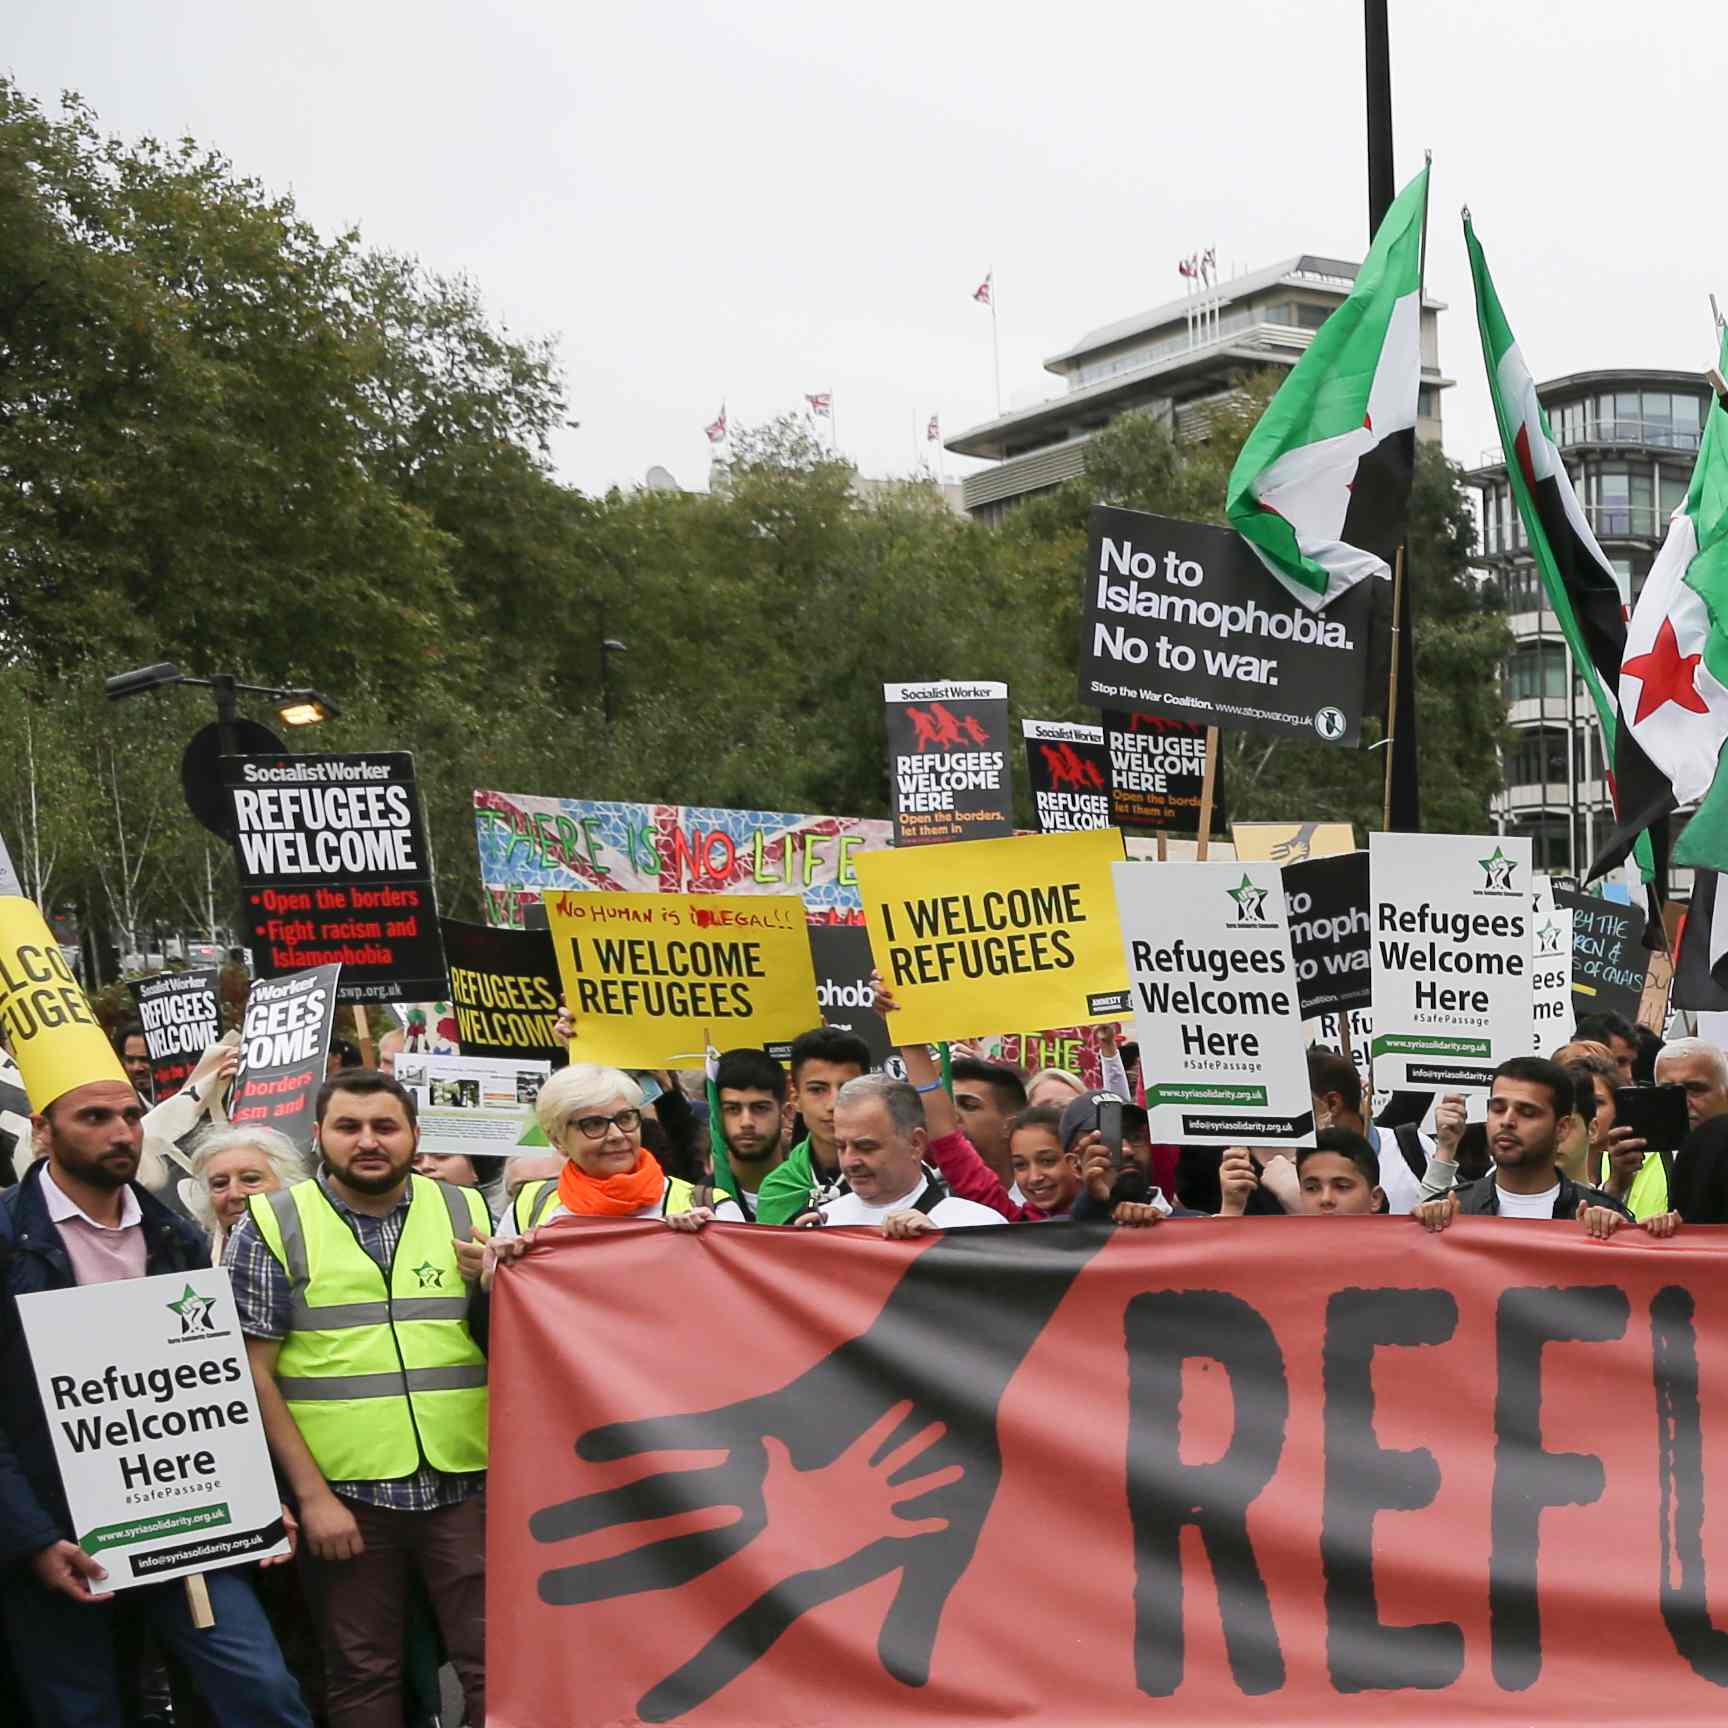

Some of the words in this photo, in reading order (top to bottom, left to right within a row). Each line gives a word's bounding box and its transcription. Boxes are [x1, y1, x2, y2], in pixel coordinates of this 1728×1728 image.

[1100, 537, 1156, 579] No
[1163, 551, 1204, 587] to
[1097, 575, 1354, 650] Islamophobia.
[1093, 623, 1148, 664] No
[1156, 635, 1196, 671] to
[1203, 649, 1278, 686] war.
[1090, 680, 1118, 697] Stop
[1119, 685, 1138, 700] the
[1139, 688, 1162, 703] War
[1163, 692, 1214, 711] Coalition.
[1108, 731, 1207, 757] REFUGEE
[896, 751, 1004, 775] REFUGEES
[1109, 751, 1206, 777] WELCOM
[896, 770, 1001, 794] WELCOME
[1111, 769, 1168, 793] HERE
[233, 785, 412, 831] REFUGEES
[898, 791, 955, 812] HERE
[1036, 791, 1109, 815] REFUGEE
[900, 811, 932, 826] Open
[934, 811, 952, 822] the
[901, 824, 918, 836] let
[919, 824, 948, 836] them
[951, 821, 963, 833] in
[1039, 809, 1111, 833] WELCOM
[239, 829, 418, 875] WELCOME
[476, 808, 612, 875] THERE
[627, 825, 662, 877] IS
[673, 826, 736, 884] NO
[753, 830, 865, 887] LIFE
[263, 888, 312, 915] Open
[316, 887, 346, 908] the
[351, 886, 420, 908] borders
[591, 904, 654, 925] HUMAN
[881, 902, 896, 943] I
[904, 883, 1088, 939] WELCOME
[267, 918, 315, 946] Fight
[322, 918, 381, 940] racism
[387, 915, 418, 937] and
[1378, 902, 1526, 944] Refugees
[1597, 914, 1630, 940] THE
[571, 936, 584, 974] I
[591, 937, 766, 979] WELCOME
[889, 930, 1077, 987] REFUGEES
[1131, 939, 1286, 982] Refugees
[1378, 940, 1525, 976] Welcome
[450, 965, 558, 1011] REFUGEES
[1602, 965, 1644, 993] CALAIS
[139, 990, 218, 1031] REFUGEES
[576, 979, 755, 1019] REFUGEES
[1137, 981, 1291, 1015] Welcome
[1414, 980, 1490, 1013] Here
[1413, 1014, 1490, 1027] #SafePassage
[145, 1019, 219, 1061] WELCOME
[1181, 1023, 1260, 1057] Here
[1384, 1038, 1488, 1054] www.syriasolidarity.org.uk
[1183, 1059, 1263, 1073] #SafePassage
[1158, 1086, 1264, 1102] www.syriasolidarity.org.uk
[1188, 1118, 1294, 1134] info@syriasolidarity.org.uk
[50, 1356, 242, 1410] Refugees
[62, 1397, 250, 1454] Welcome
[119, 1448, 217, 1490] Here
[125, 1479, 224, 1505] #SafePassage
[95, 1506, 226, 1544] www.syriasolidarity.org.uk
[137, 1532, 265, 1570] info@syriasolidarity.org.uk
